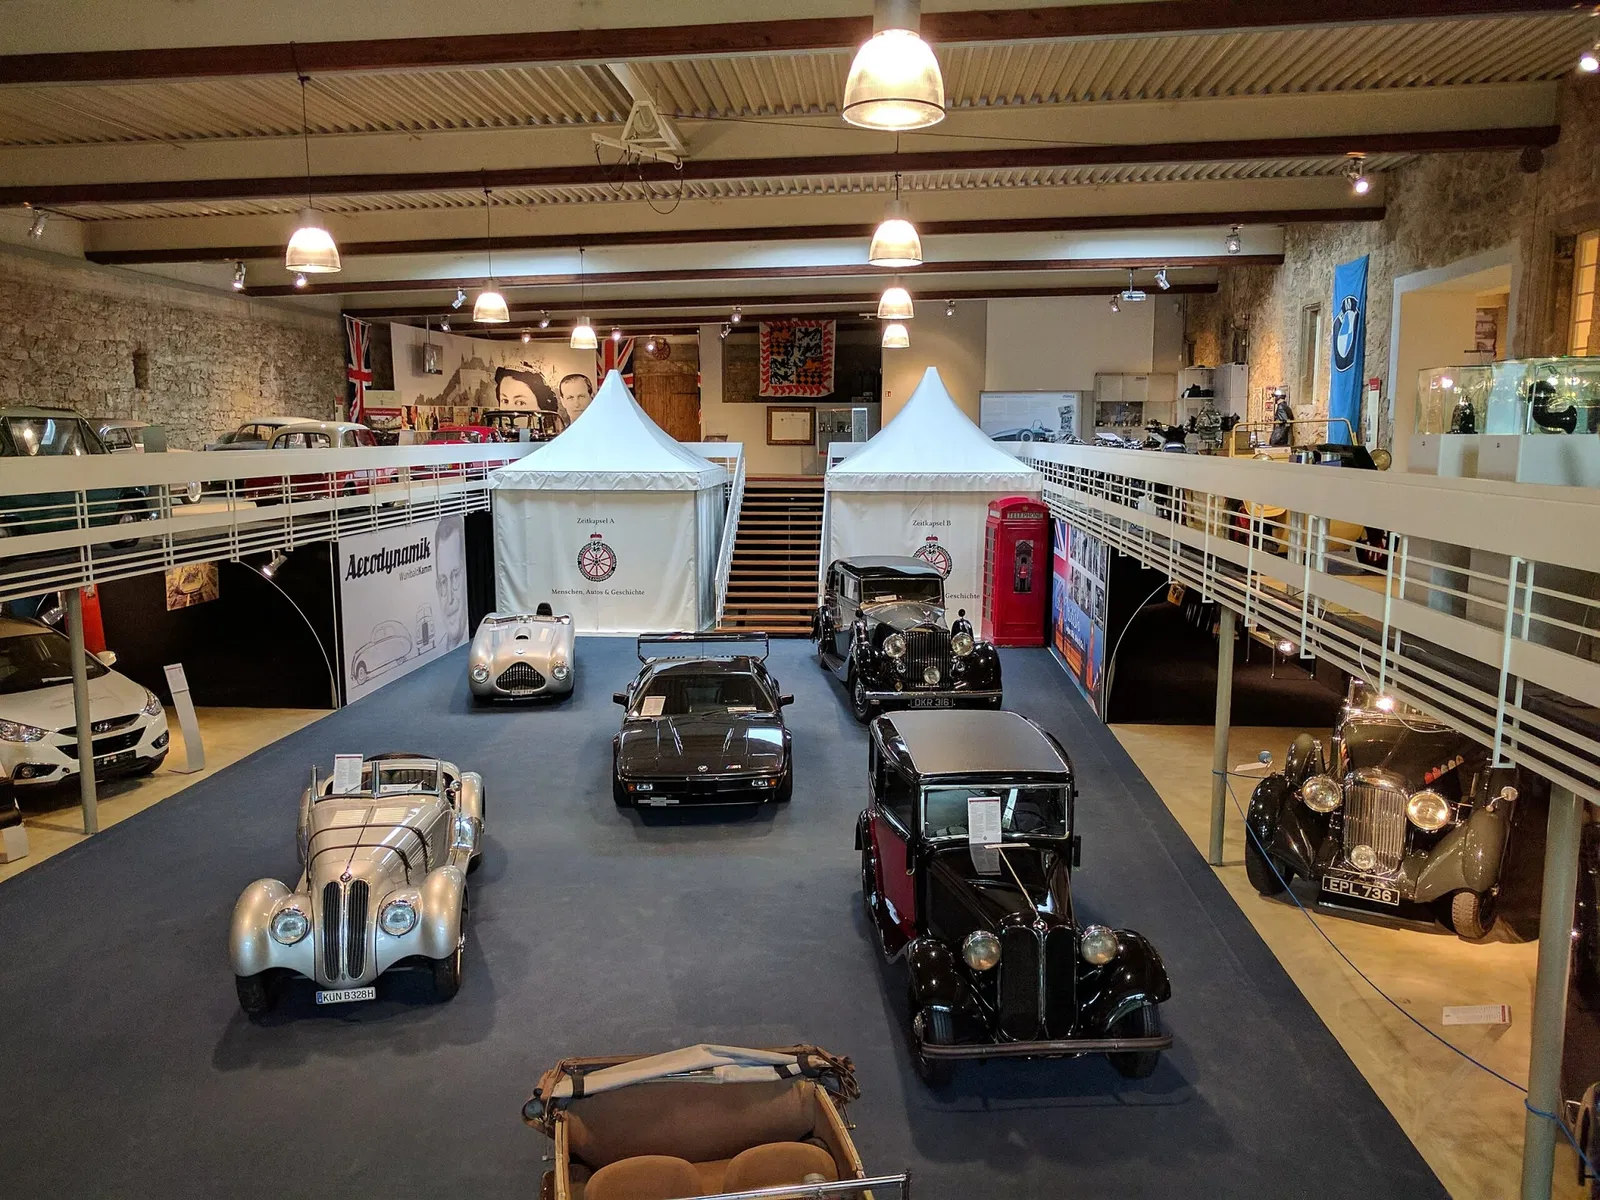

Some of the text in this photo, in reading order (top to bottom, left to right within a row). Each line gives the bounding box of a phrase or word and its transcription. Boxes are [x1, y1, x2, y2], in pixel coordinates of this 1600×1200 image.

[345, 537, 431, 581] Aerodynamik
[551, 588, 585, 596] Menschen,
[611, 588, 645, 596] Geschichte
[914, 698, 950, 706] DKR 316
[1329, 879, 1392, 902] EPL 736
